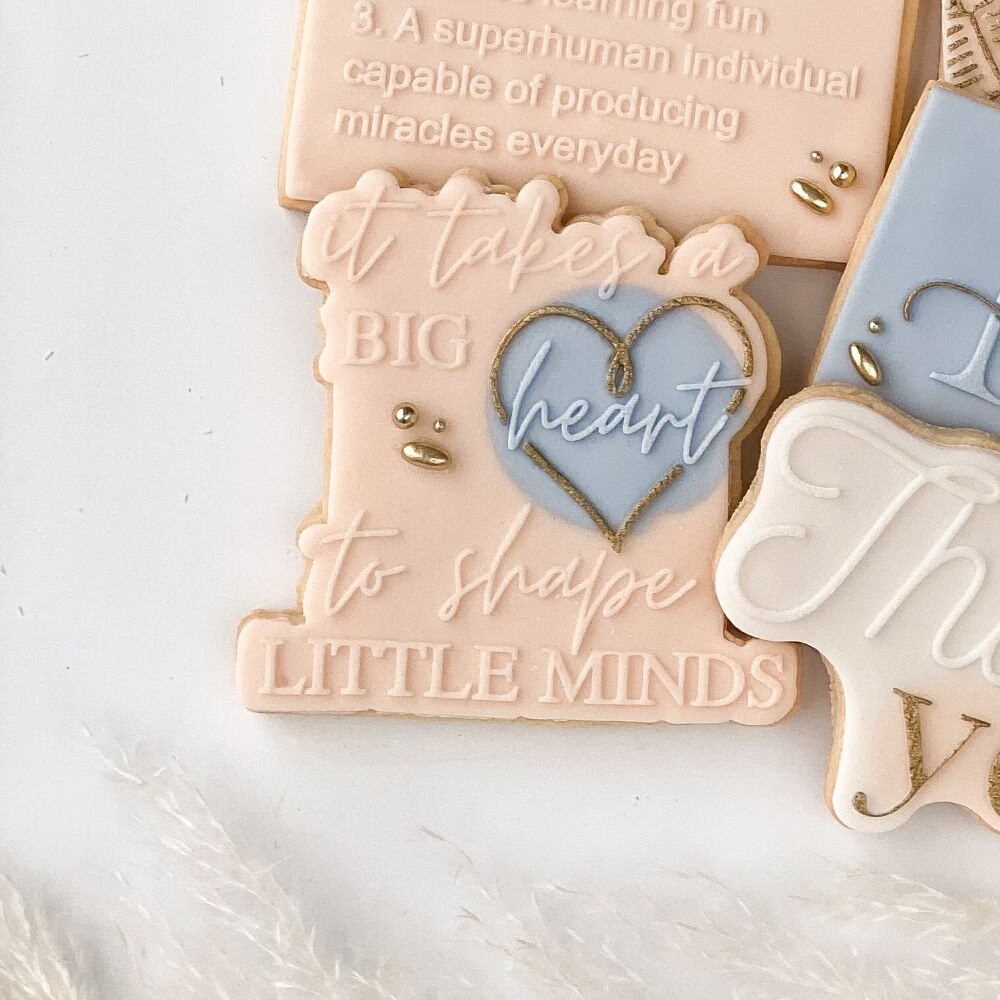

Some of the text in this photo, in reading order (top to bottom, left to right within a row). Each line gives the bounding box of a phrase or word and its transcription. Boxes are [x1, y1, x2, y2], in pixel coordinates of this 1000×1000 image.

[350, 0, 862, 100] 3. A superhuman individual
[342, 56, 743, 140] capable of producing
[333, 106, 685, 186] miracles everyday
[323, 185, 746, 301] it takes a
[343, 310, 474, 370] BIG
[506, 340, 754, 466] heart
[320, 503, 698, 655] to shape
[257, 638, 787, 710] LITTLE MINDS
